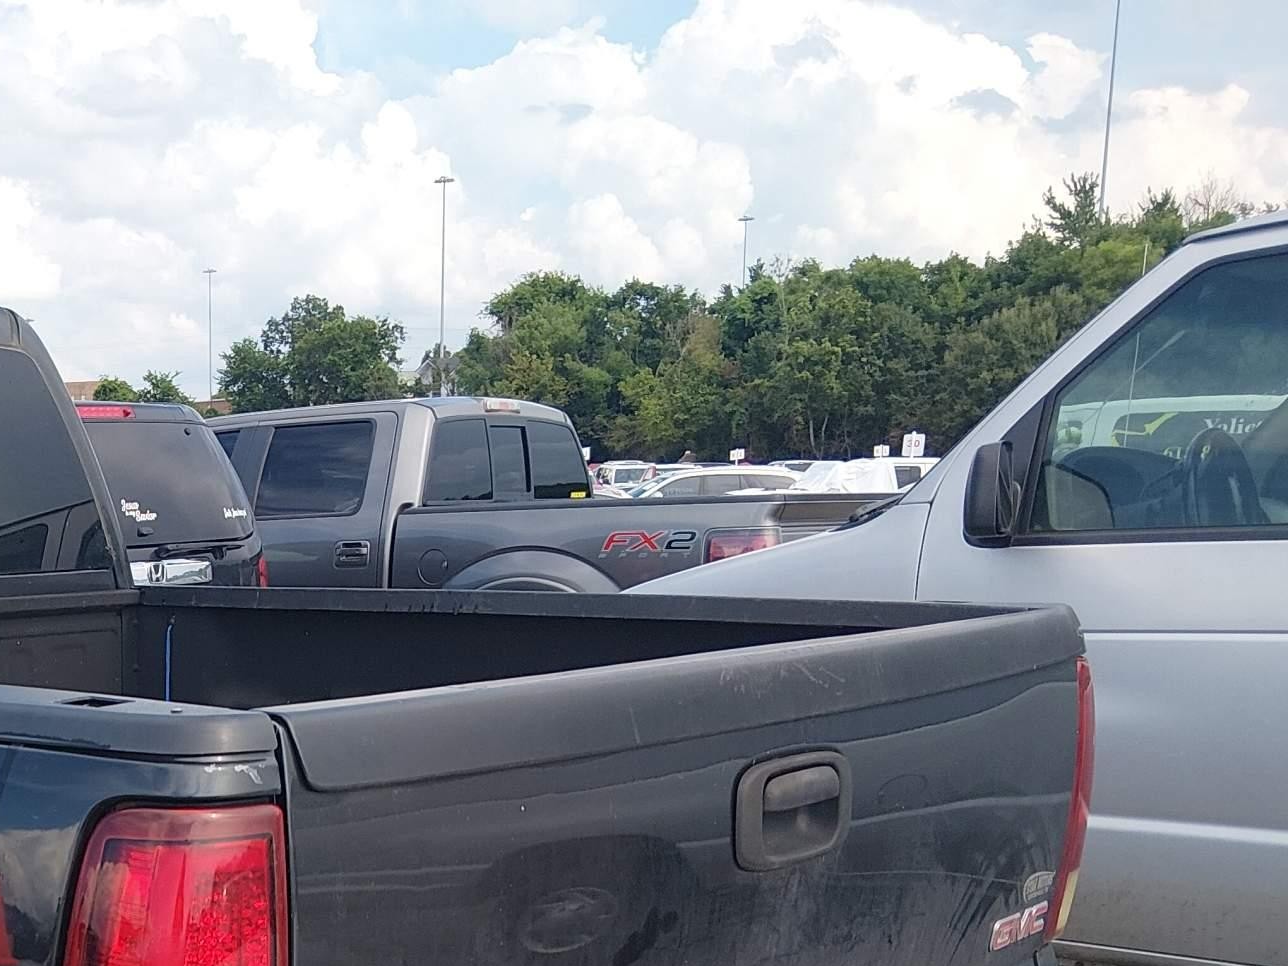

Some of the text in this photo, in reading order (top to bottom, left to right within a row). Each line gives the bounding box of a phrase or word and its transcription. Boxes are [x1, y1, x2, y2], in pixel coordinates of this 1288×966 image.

[600, 529, 699, 552] FX2
[598, 551, 691, 559] SPORT
[989, 901, 1048, 953] GMC
